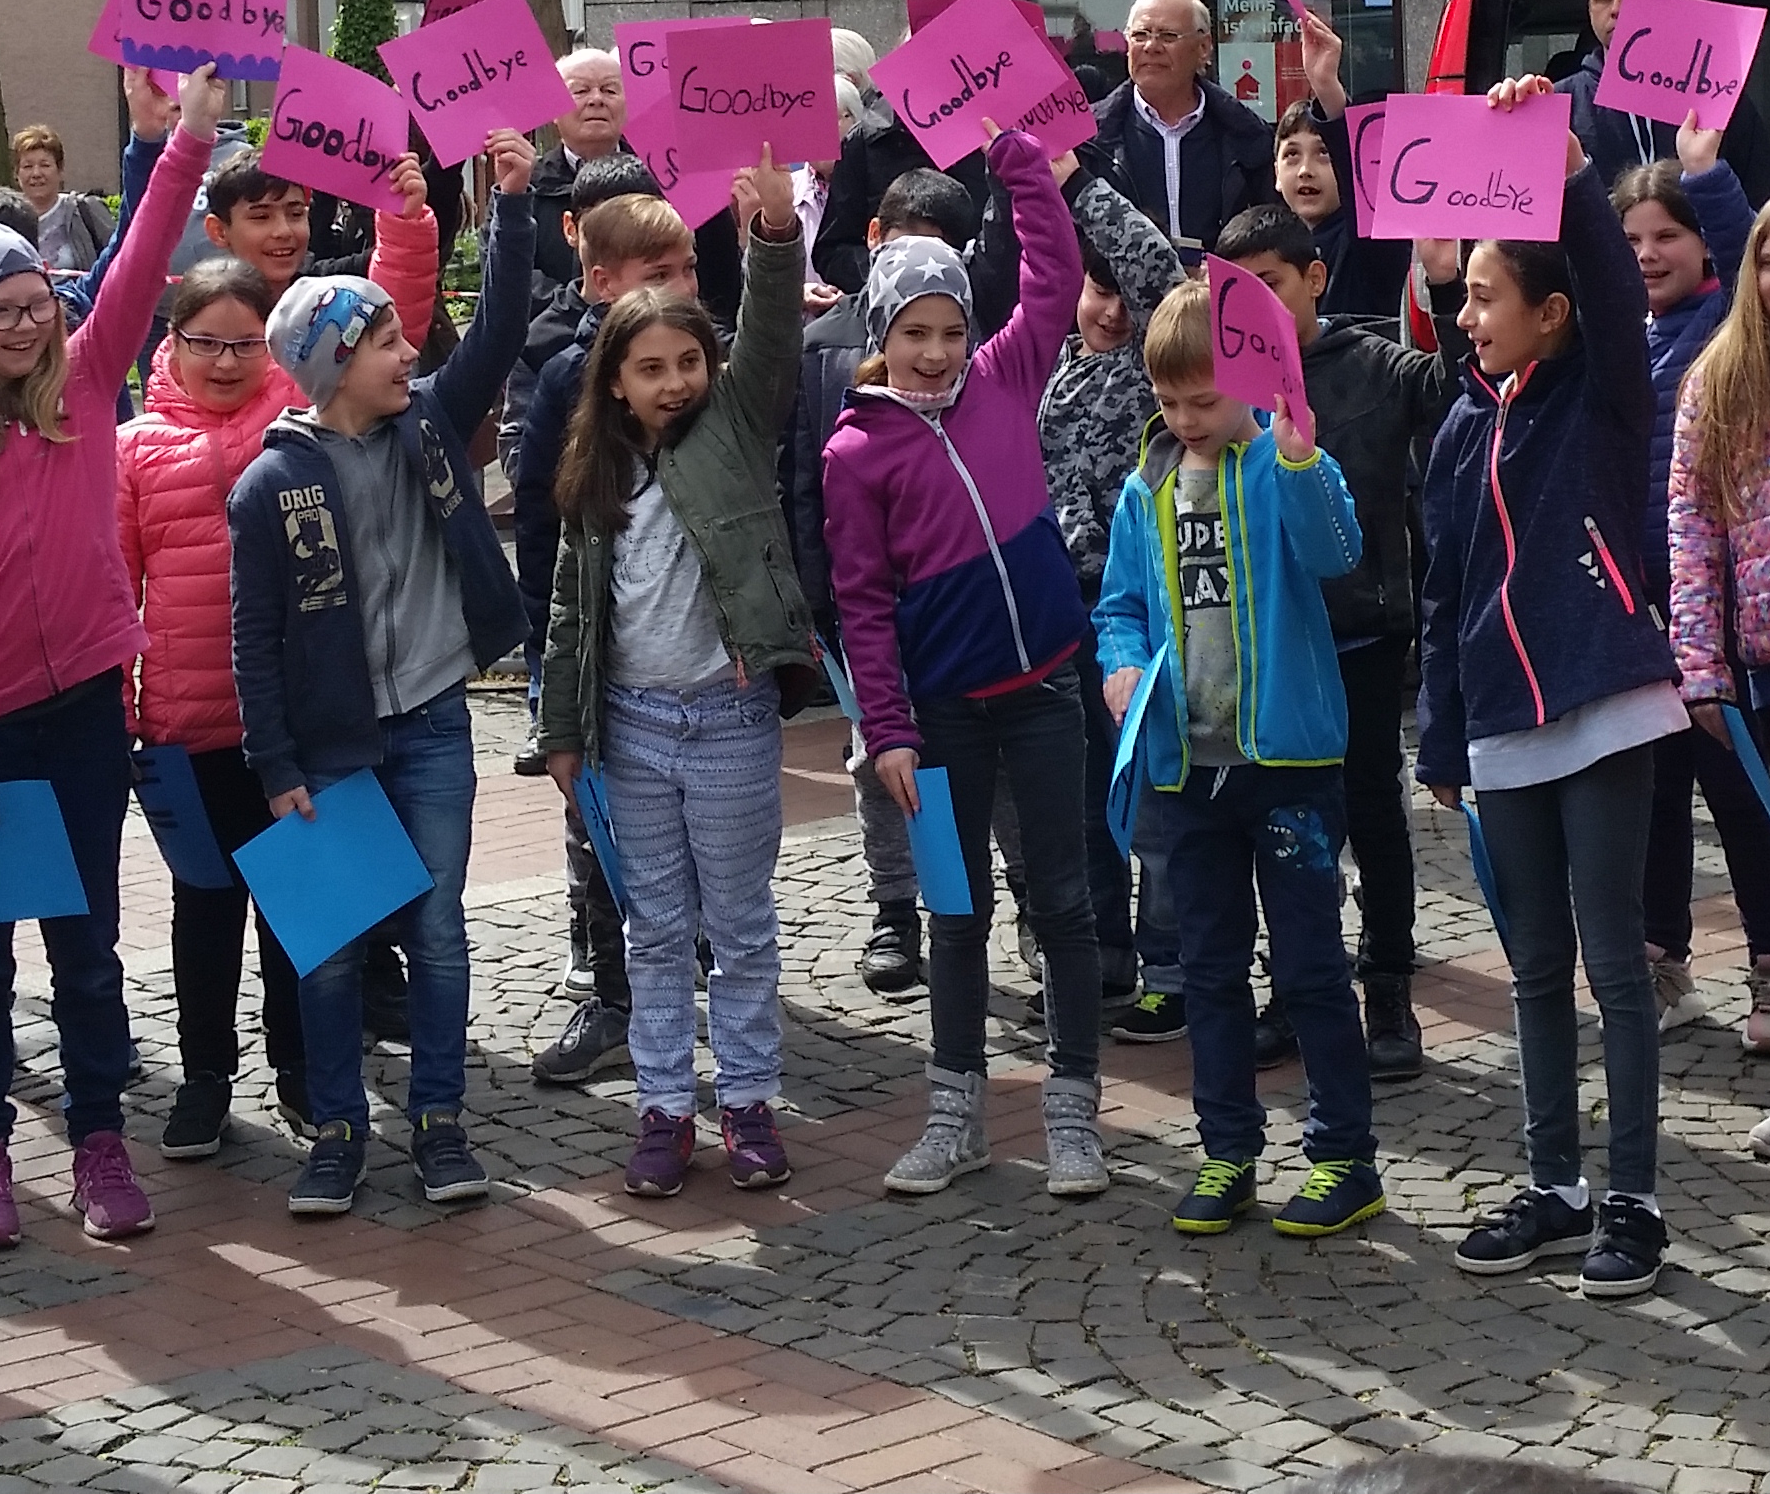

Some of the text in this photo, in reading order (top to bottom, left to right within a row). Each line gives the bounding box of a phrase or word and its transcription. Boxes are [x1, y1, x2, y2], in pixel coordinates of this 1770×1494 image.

[412, 47, 528, 113] Goodbye
[679, 65, 817, 119] Goodbye
[902, 50, 1014, 130] Goodbye
[1617, 27, 1739, 100] Goodbye
[273, 88, 403, 185] Goodby
[1389, 137, 1534, 216] Goodbye
[278, 484, 326, 513] ORIG
